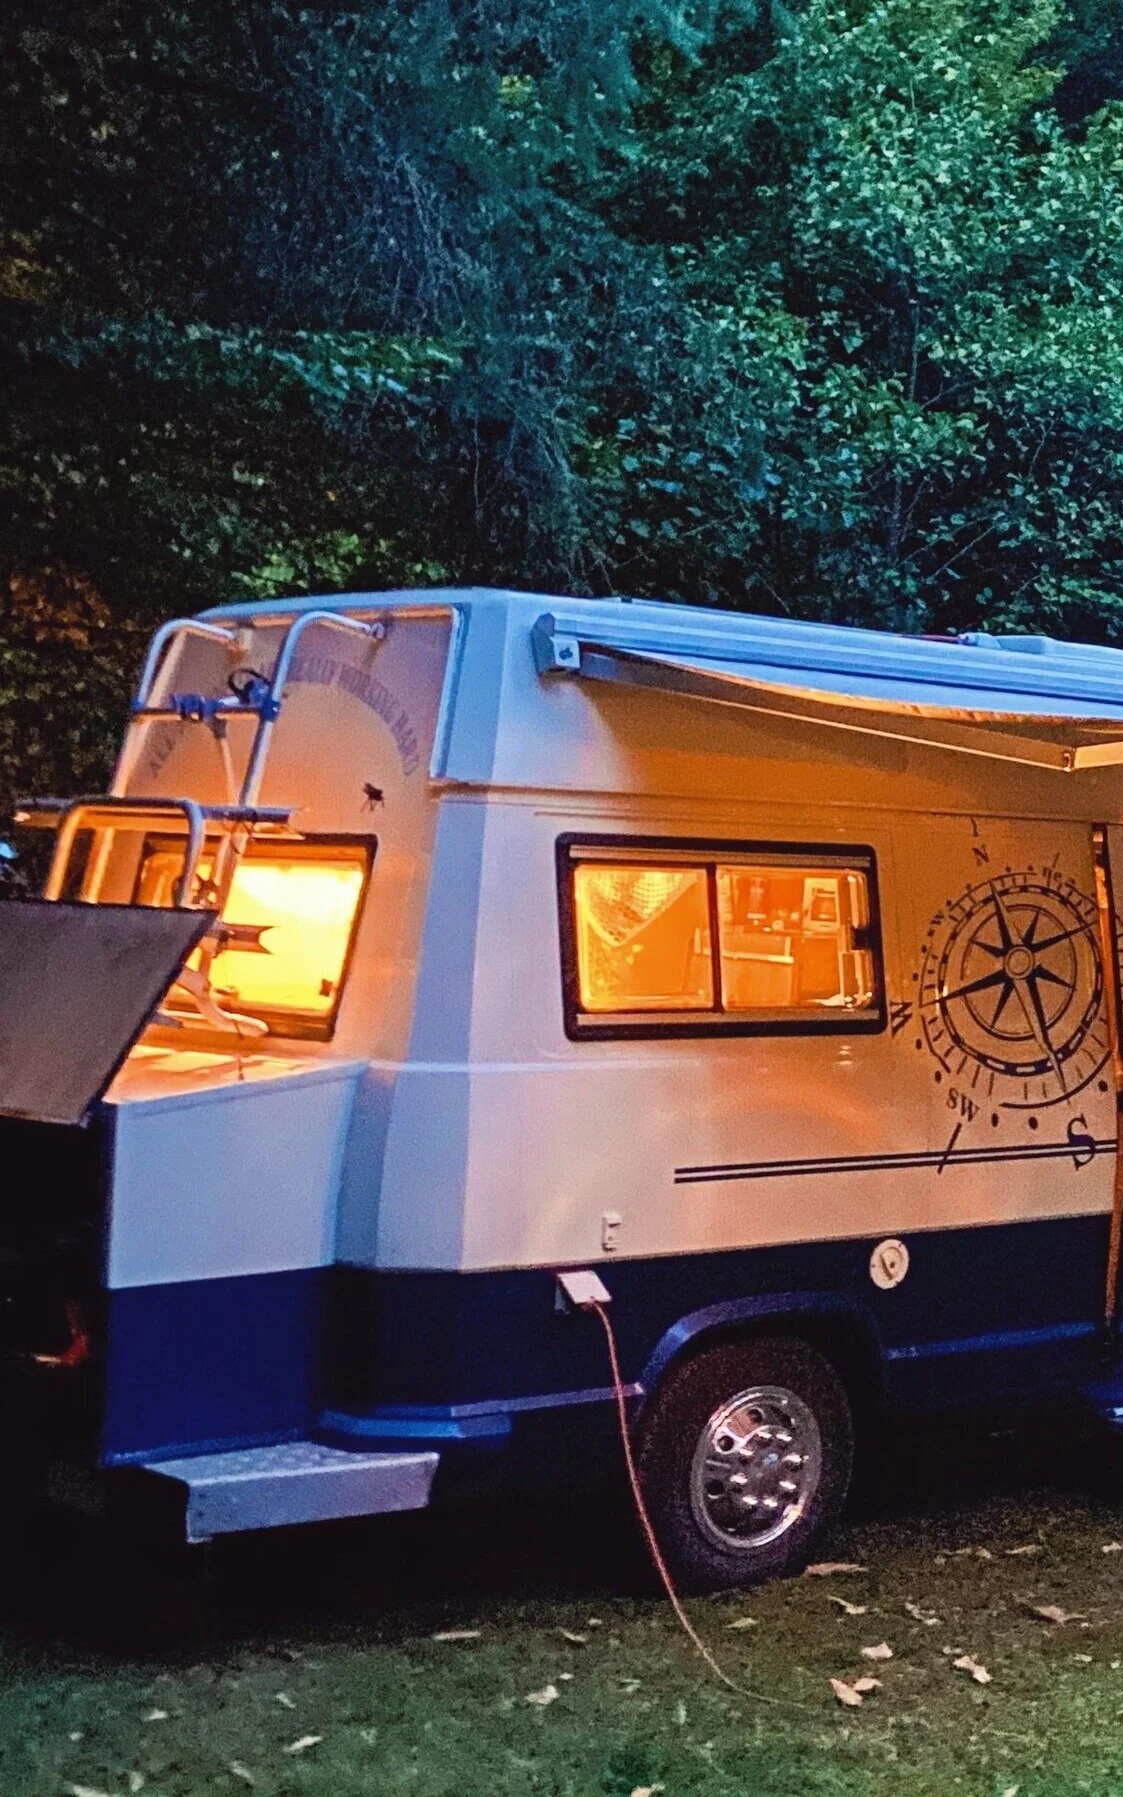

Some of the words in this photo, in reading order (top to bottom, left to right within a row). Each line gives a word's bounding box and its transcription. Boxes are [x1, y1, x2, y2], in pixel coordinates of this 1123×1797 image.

[972, 846, 990, 866] N
[889, 1000, 913, 1036] W
[1067, 1113, 1096, 1170] S
